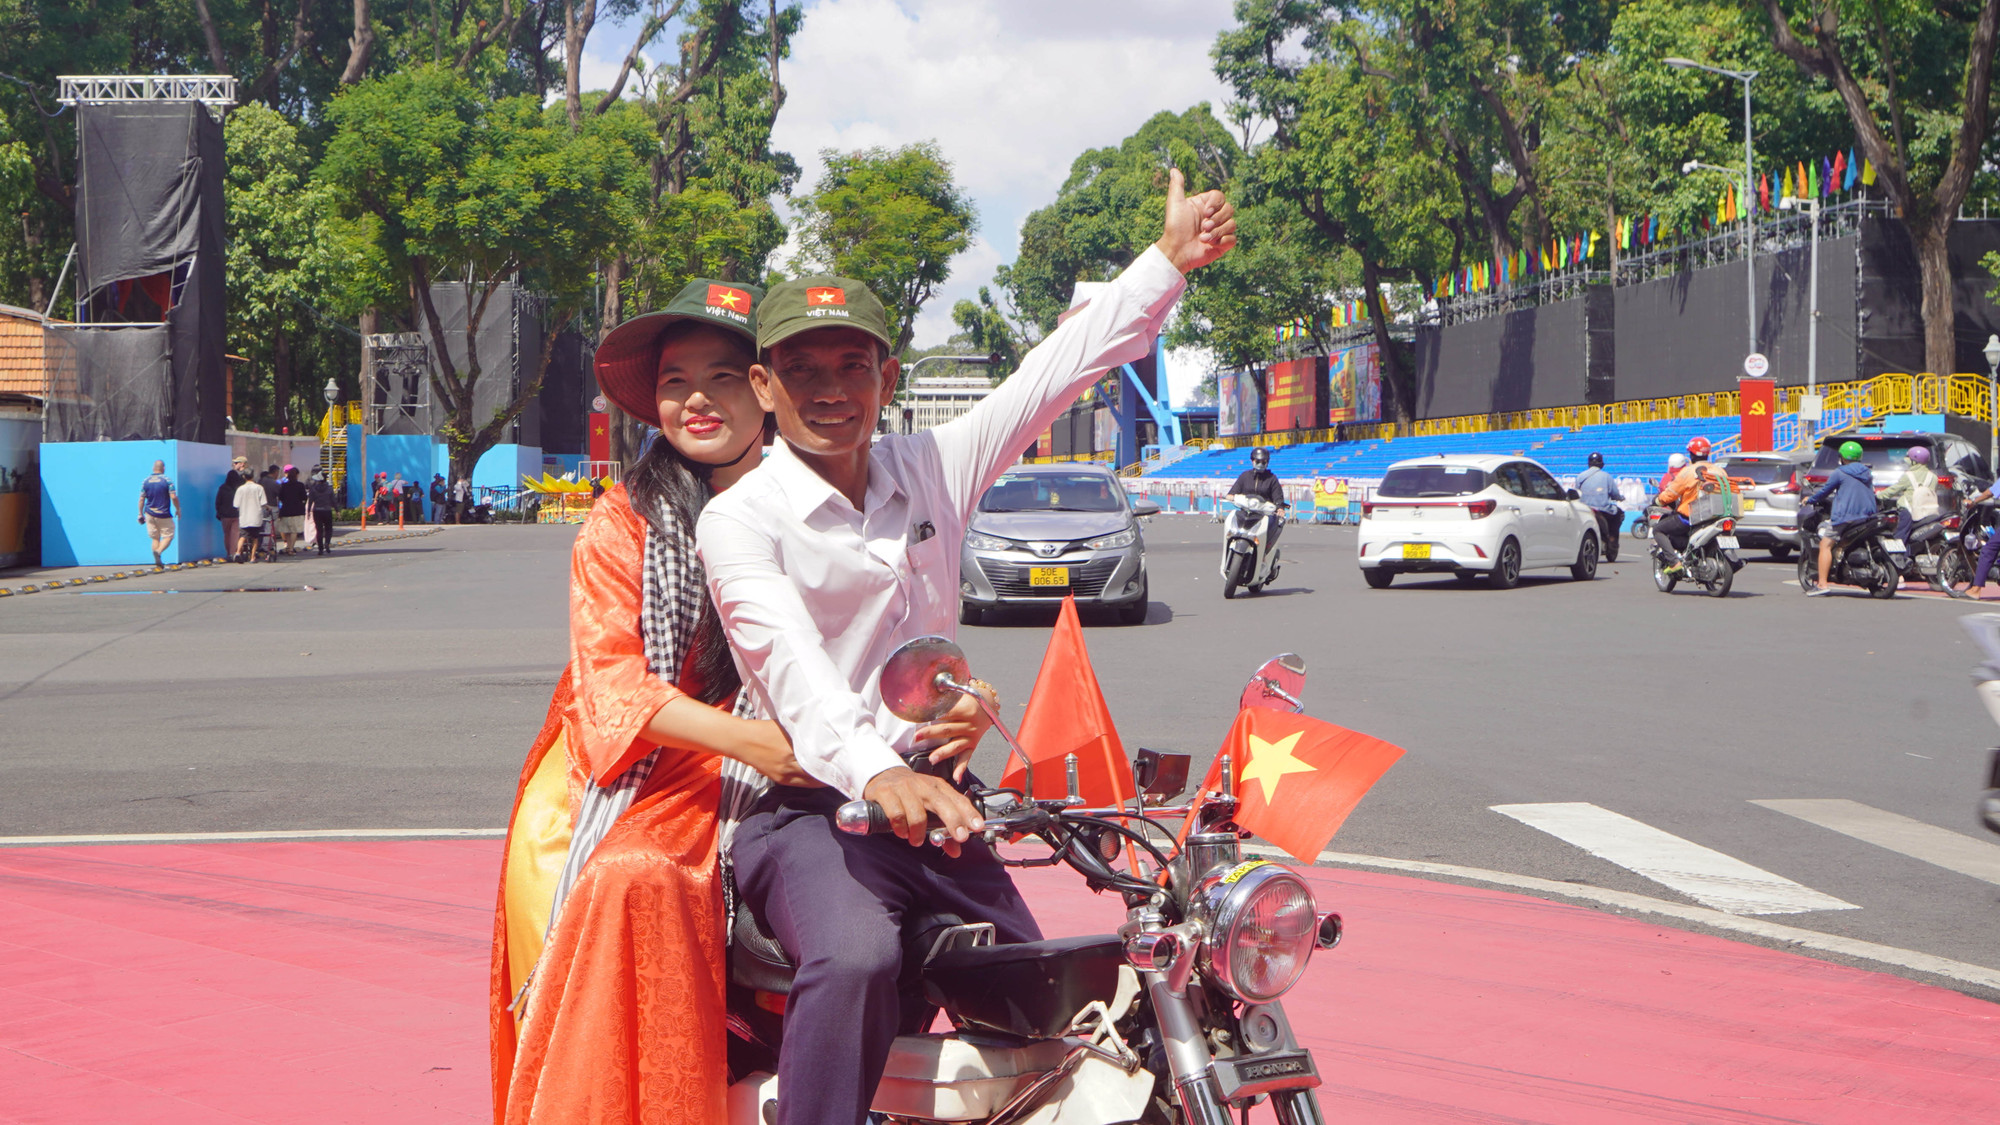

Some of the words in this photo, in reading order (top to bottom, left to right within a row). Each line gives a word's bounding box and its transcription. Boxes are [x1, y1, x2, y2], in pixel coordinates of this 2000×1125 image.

[706, 306, 726, 317] Việt
[728, 310, 748, 324] Nam
[806, 307, 828, 317] VIỆT
[829, 309, 849, 318] NAM
[1040, 567, 1058, 577] 50E
[1034, 576, 1065, 586] 006.65
[1245, 1061, 1304, 1079] HONDA
